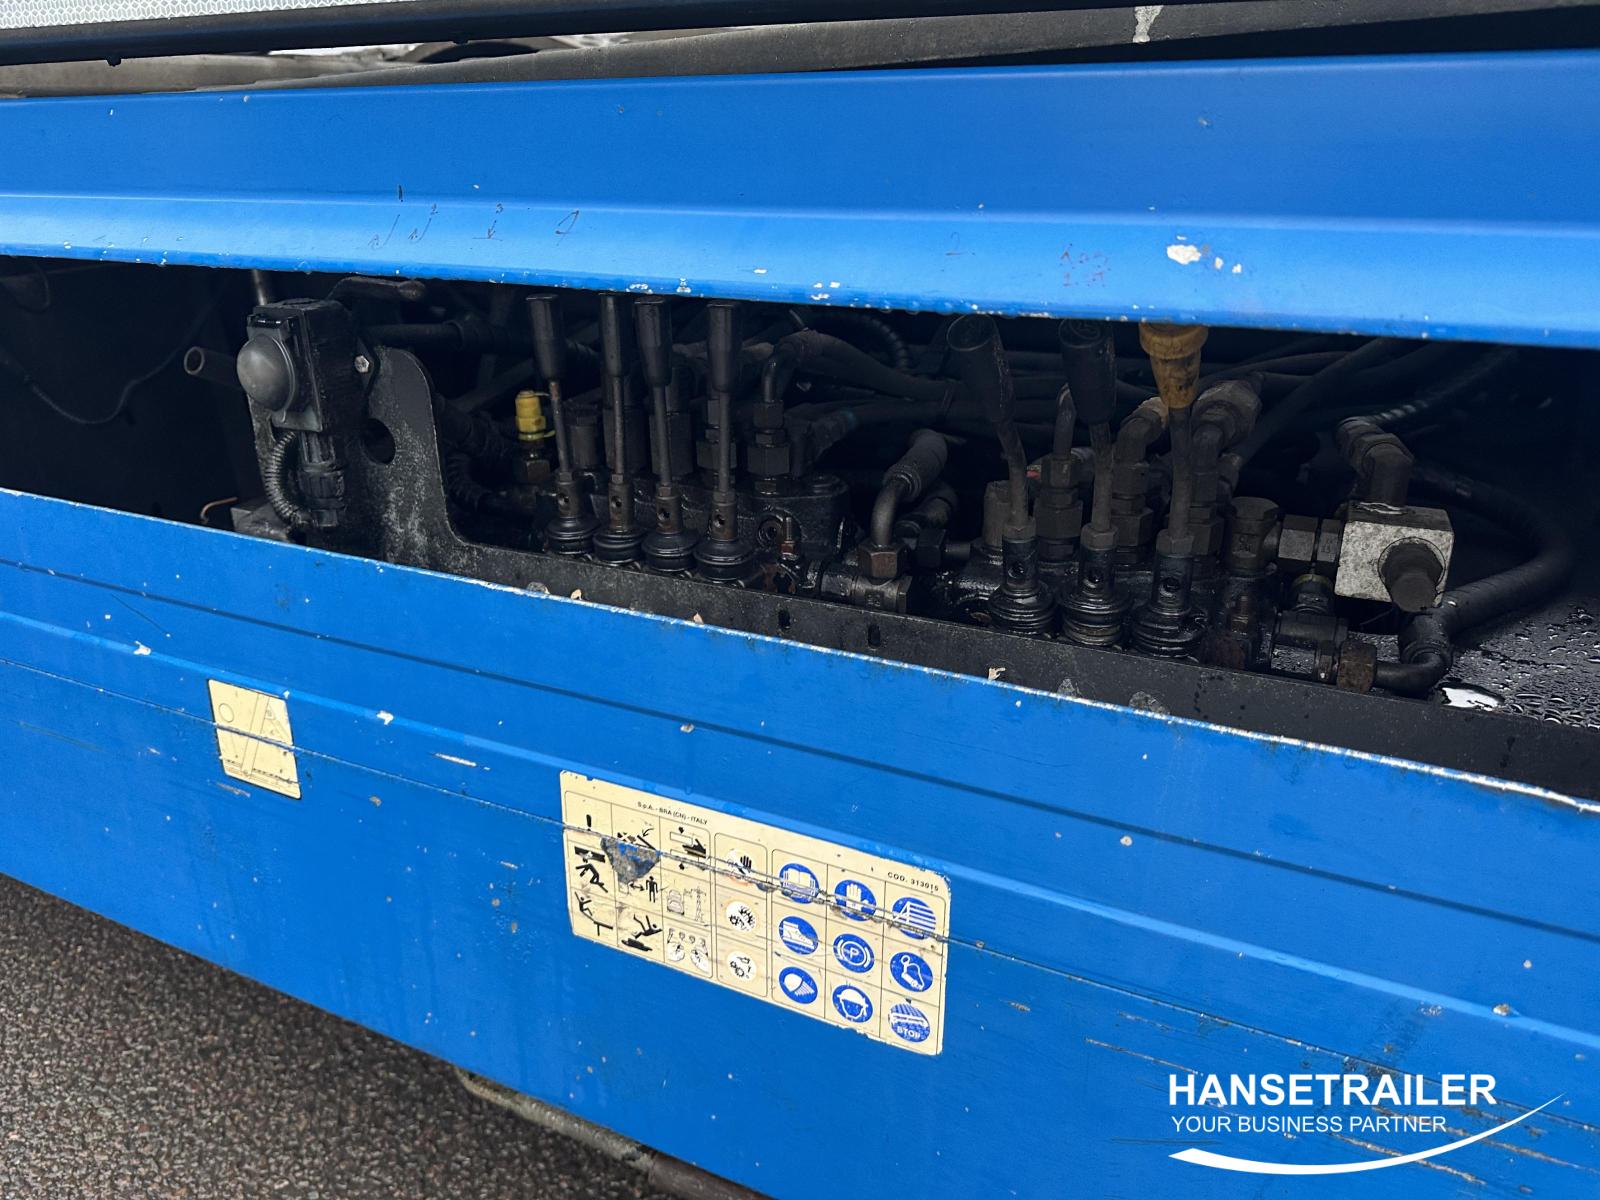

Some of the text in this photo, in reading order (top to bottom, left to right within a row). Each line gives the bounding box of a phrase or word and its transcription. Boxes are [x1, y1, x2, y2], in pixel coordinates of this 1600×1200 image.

[659, 807, 672, 816] BRA
[690, 816, 707, 825] ITALY
[887, 871, 908, 883] COD.
[897, 1026, 921, 1039] STOP
